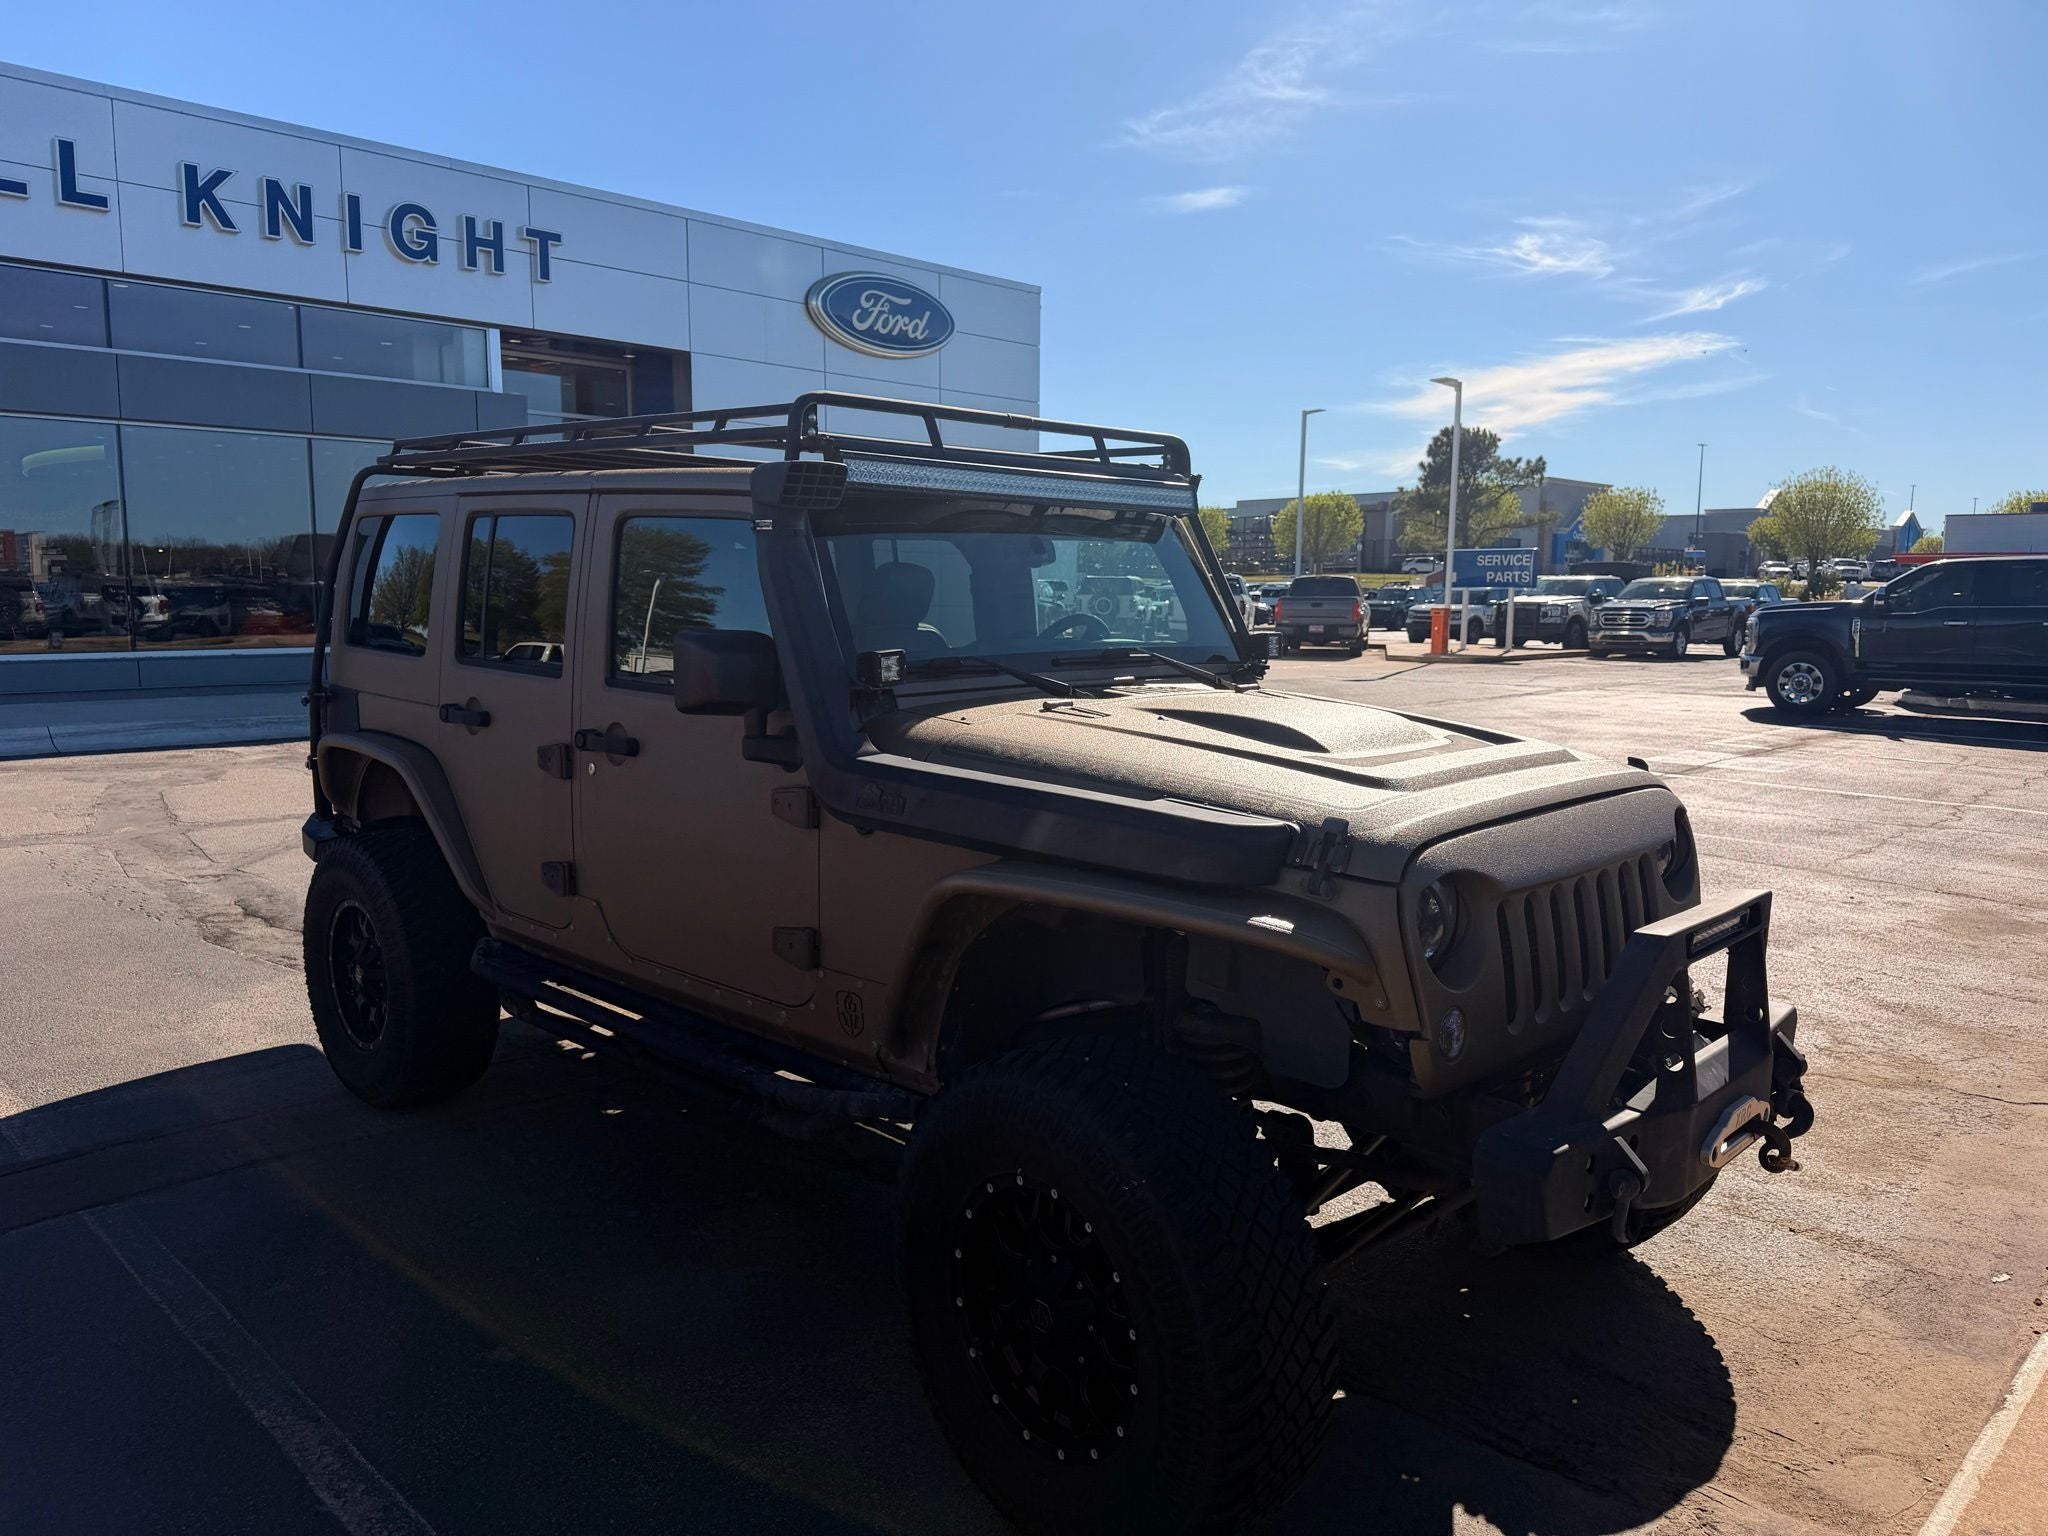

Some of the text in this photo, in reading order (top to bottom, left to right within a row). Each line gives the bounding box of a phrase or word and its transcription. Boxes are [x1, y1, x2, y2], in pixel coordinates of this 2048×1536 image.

[180, 160, 562, 283] KNIGHT
[852, 290, 930, 340] Ford
[1476, 554, 1531, 566] SERVICE
[1486, 571, 1530, 583] PARTS
